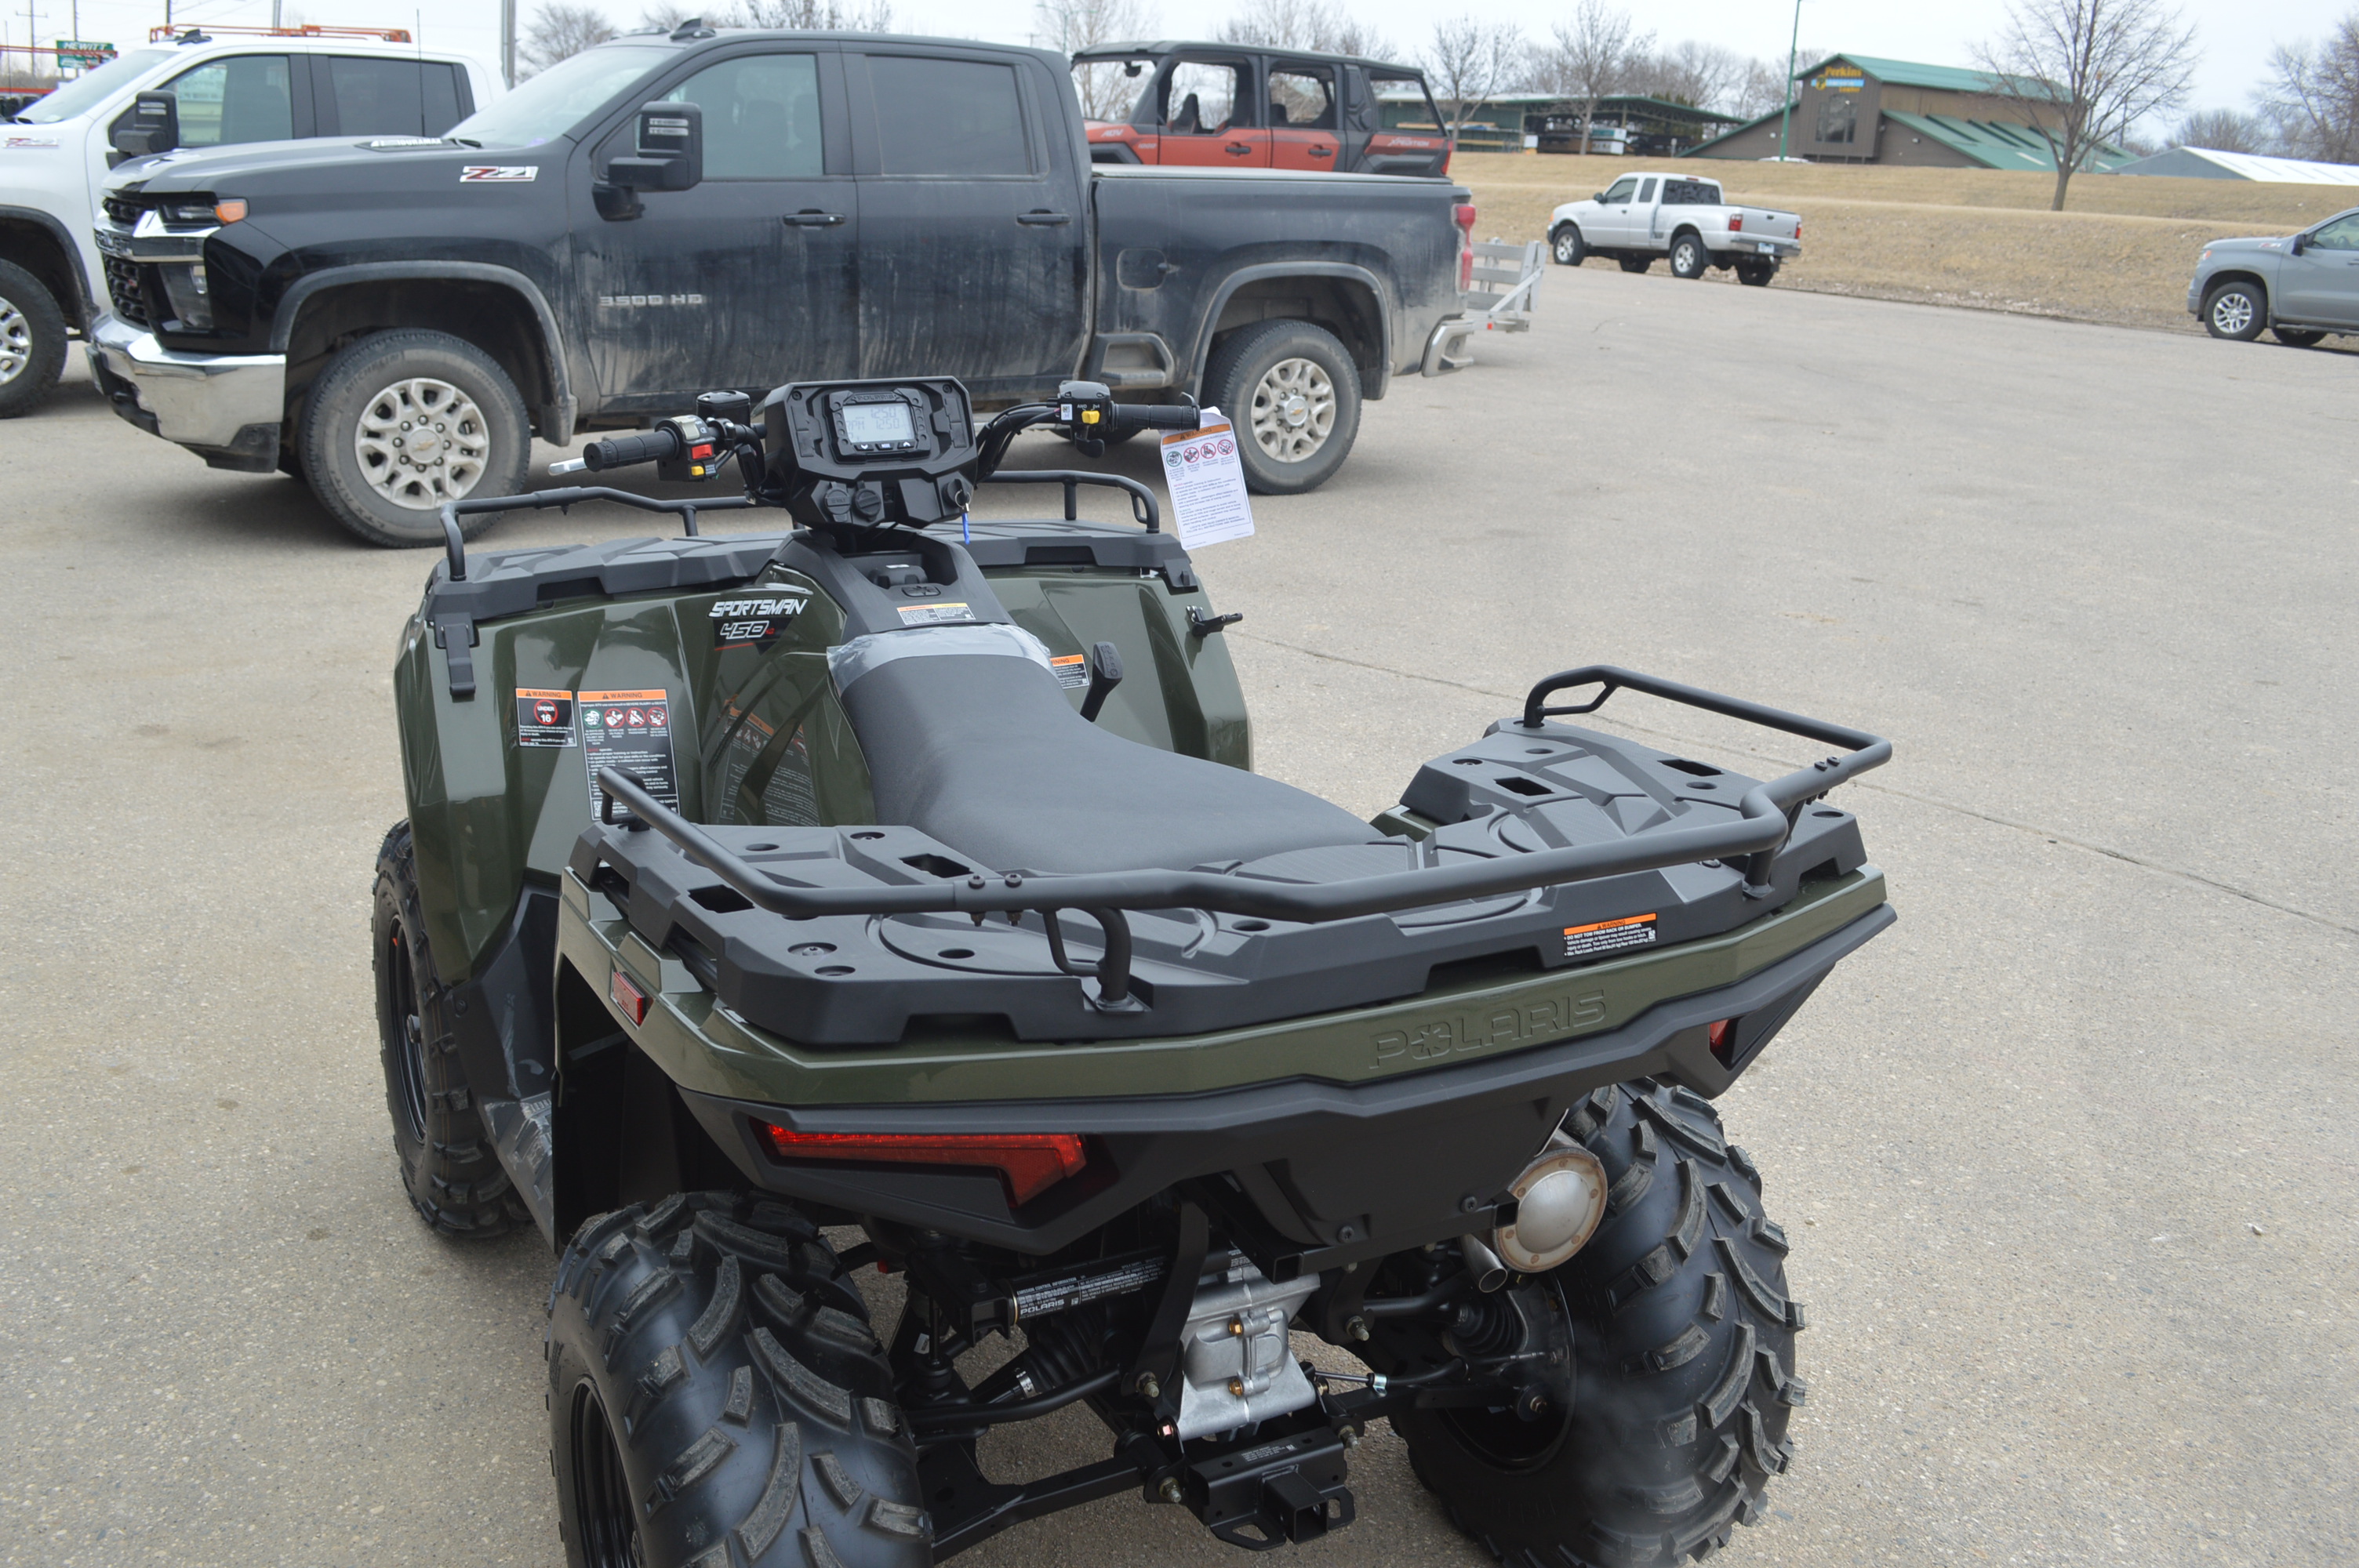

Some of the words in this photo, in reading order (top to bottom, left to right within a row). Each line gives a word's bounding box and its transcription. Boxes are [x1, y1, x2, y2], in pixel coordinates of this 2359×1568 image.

[1825, 67, 1863, 77] Perkins
[460, 165, 539, 183] Z71
[599, 295, 663, 307] 3500
[671, 293, 703, 305] HD
[876, 418, 900, 430] 1250
[1187, 427, 1212, 437] WARNING
[708, 598, 808, 618] SPORTSMAN
[720, 620, 769, 640] 450
[540, 713, 552, 723] 16
[1369, 989, 1607, 1069] POLARIS
[1020, 1298, 1065, 1316] POLARIS
